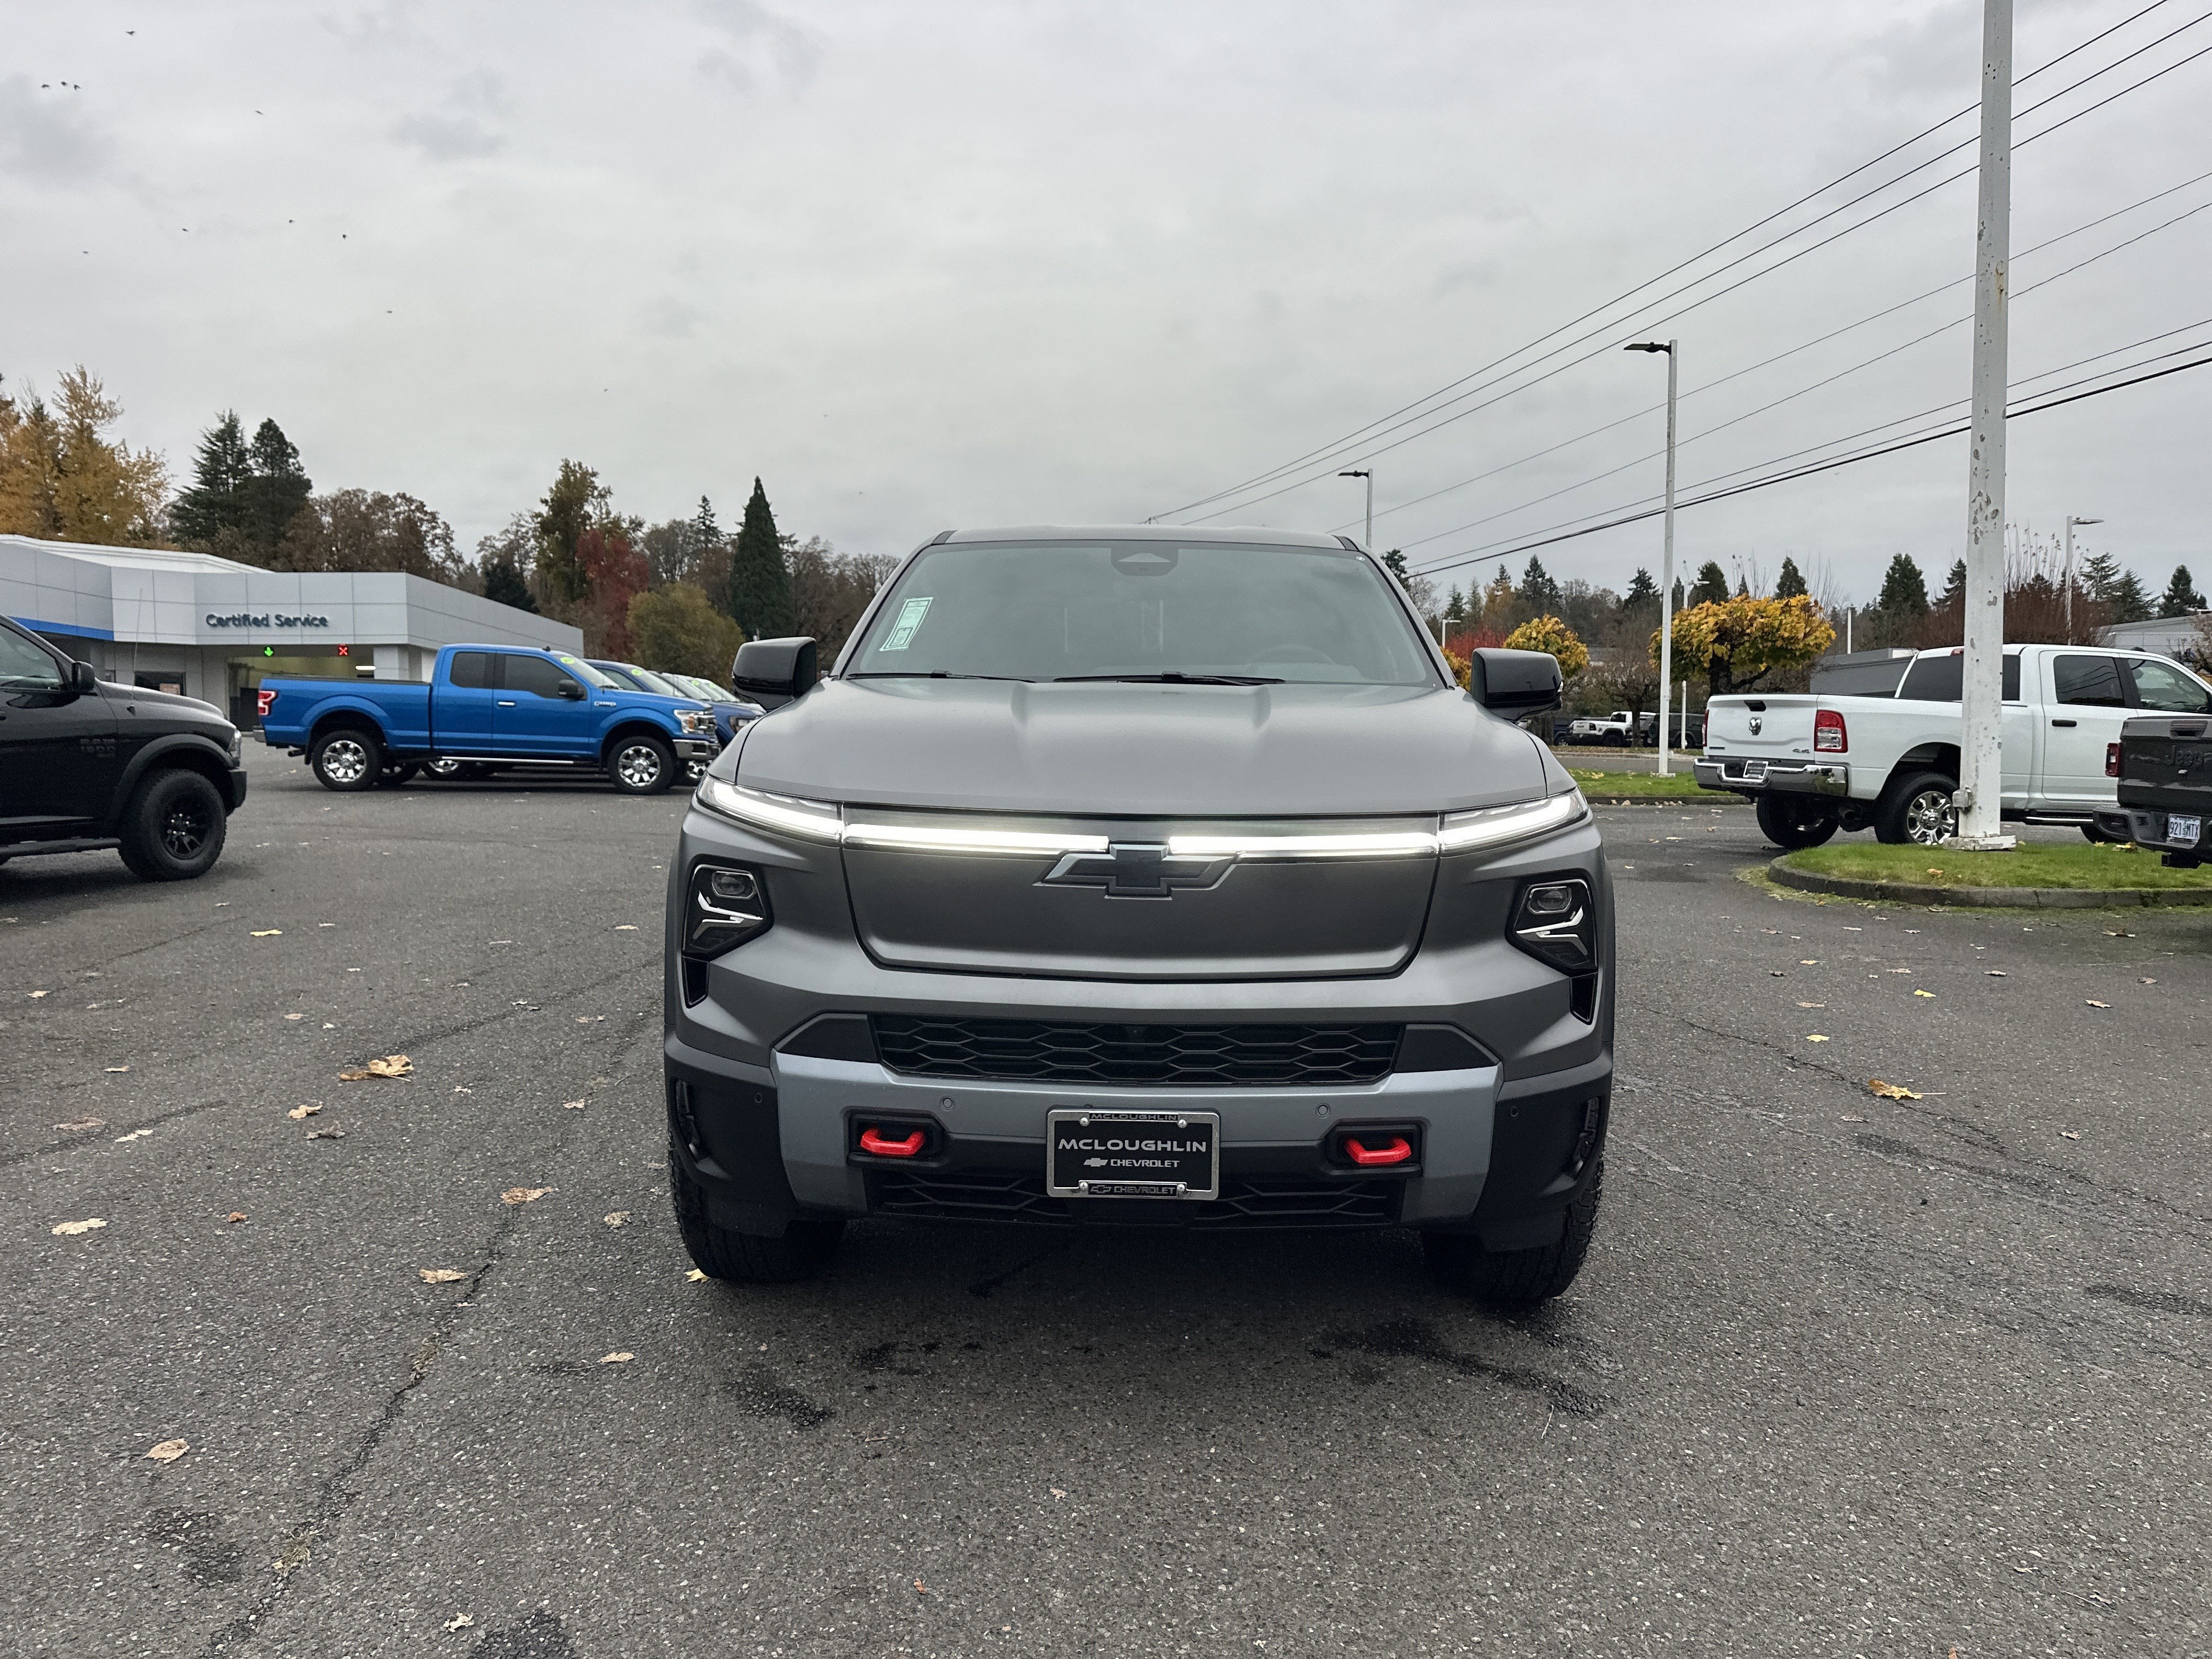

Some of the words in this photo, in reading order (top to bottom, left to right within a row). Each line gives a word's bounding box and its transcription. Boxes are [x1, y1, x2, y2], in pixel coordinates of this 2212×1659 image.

[206, 613, 270, 627] Certified
[275, 613, 329, 627] Service
[2165, 745, 2204, 771] Jeep
[1058, 1138, 1206, 1152] MCLOUGHLIN
[1110, 1159, 1180, 1168] CHEVROLET
[1114, 1186, 1176, 1195] CHEVROLET
